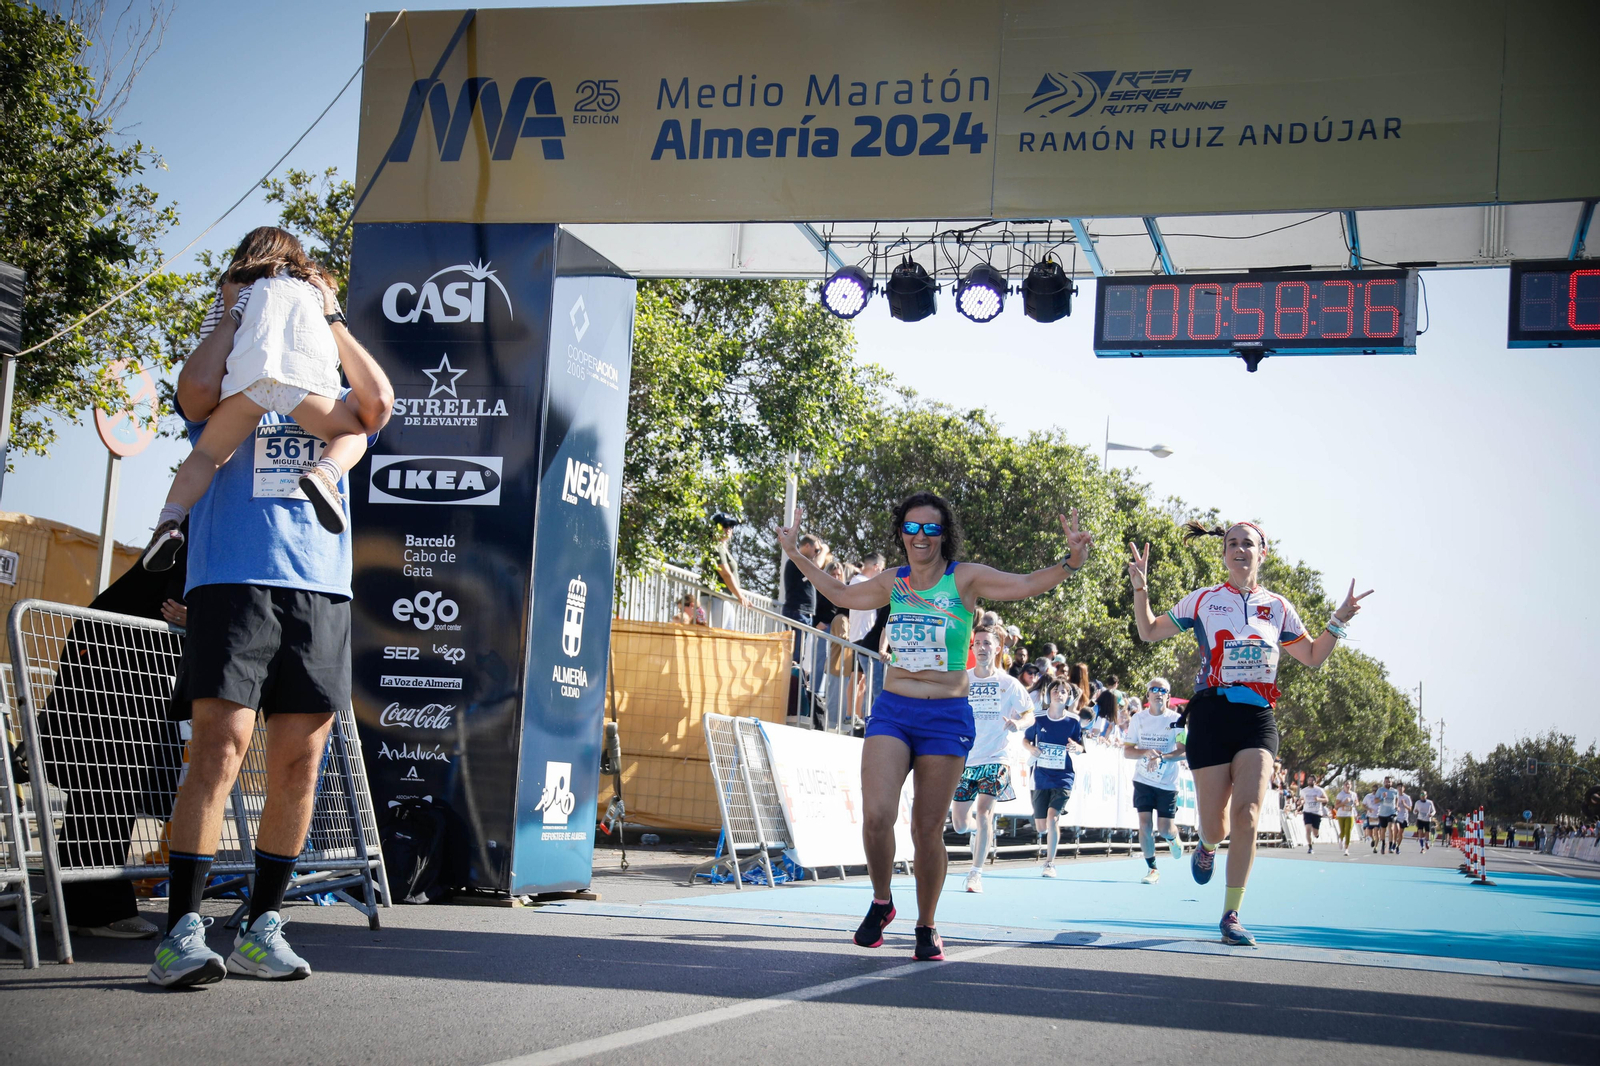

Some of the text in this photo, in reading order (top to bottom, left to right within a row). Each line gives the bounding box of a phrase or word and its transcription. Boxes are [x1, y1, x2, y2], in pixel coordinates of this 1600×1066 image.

[1116, 69, 1193, 88] RFEA
[574, 79, 621, 112] 25
[657, 68, 990, 110] Medio Maratón
[1107, 87, 1184, 102] SERIES
[1100, 100, 1229, 116] RUTA RUNNING
[573, 113, 619, 124] EDICIÓN
[651, 112, 989, 161] Almería 2024
[1019, 115, 1403, 153] RAMÓN RUIZ ANDÚJAR
[382, 281, 486, 324] CASI
[567, 343, 619, 384] COOPERACIÓN
[567, 359, 586, 381] 2005
[392, 398, 509, 417] STRELLA
[404, 416, 478, 427] DE LEVANTE
[272, 458, 301, 466] MIGUEL
[387, 469, 487, 491] IKEA
[405, 534, 456, 548] Barceló
[404, 549, 456, 563] Cabo de
[403, 564, 433, 577] Gata
[392, 590, 459, 631] ego
[433, 624, 447, 632] sport
[890, 623, 937, 643] 5551
[383, 646, 420, 660] SER
[382, 677, 393, 686] La
[394, 678, 411, 687] Voz
[411, 678, 424, 687] de
[552, 664, 588, 688] ALMERÍA
[561, 685, 580, 699] CIUDAD
[969, 686, 997, 696] 5443
[379, 702, 457, 730] Coca-Cola
[378, 741, 451, 763] Andalucía
